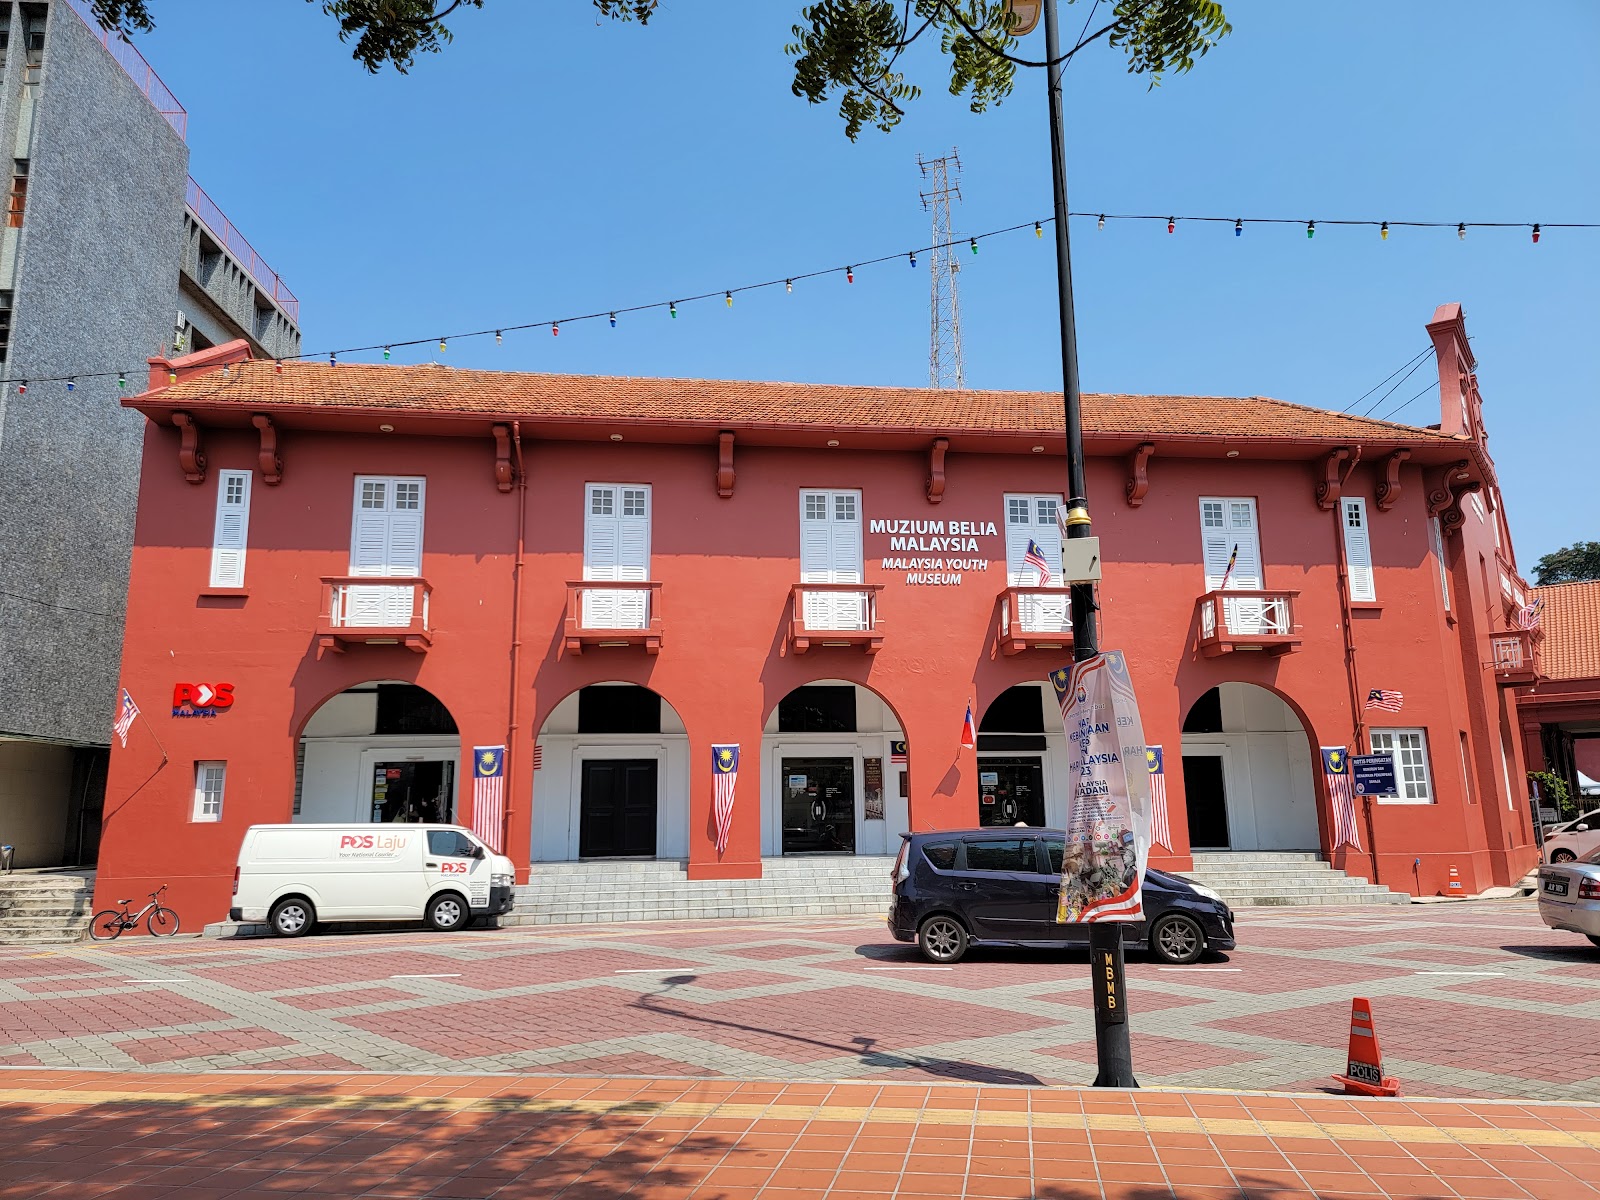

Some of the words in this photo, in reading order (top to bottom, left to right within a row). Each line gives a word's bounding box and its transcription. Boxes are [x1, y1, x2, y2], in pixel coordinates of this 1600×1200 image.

[869, 519, 945, 535] MUZIUM
[948, 521, 998, 536] BELIA
[890, 536, 979, 552] MALAYSIA
[881, 557, 943, 571] MALAYSIA
[945, 558, 988, 571] YOUTH
[906, 572, 962, 585] MUSEUM
[173, 682, 235, 707] POS
[1078, 779, 1107, 788] ALAYSIA
[340, 835, 374, 849] POS
[377, 834, 406, 852] Laju
[441, 862, 467, 873] POS
[1104, 952, 1116, 1009] MBMB
[1350, 1064, 1379, 1081] POLIS
